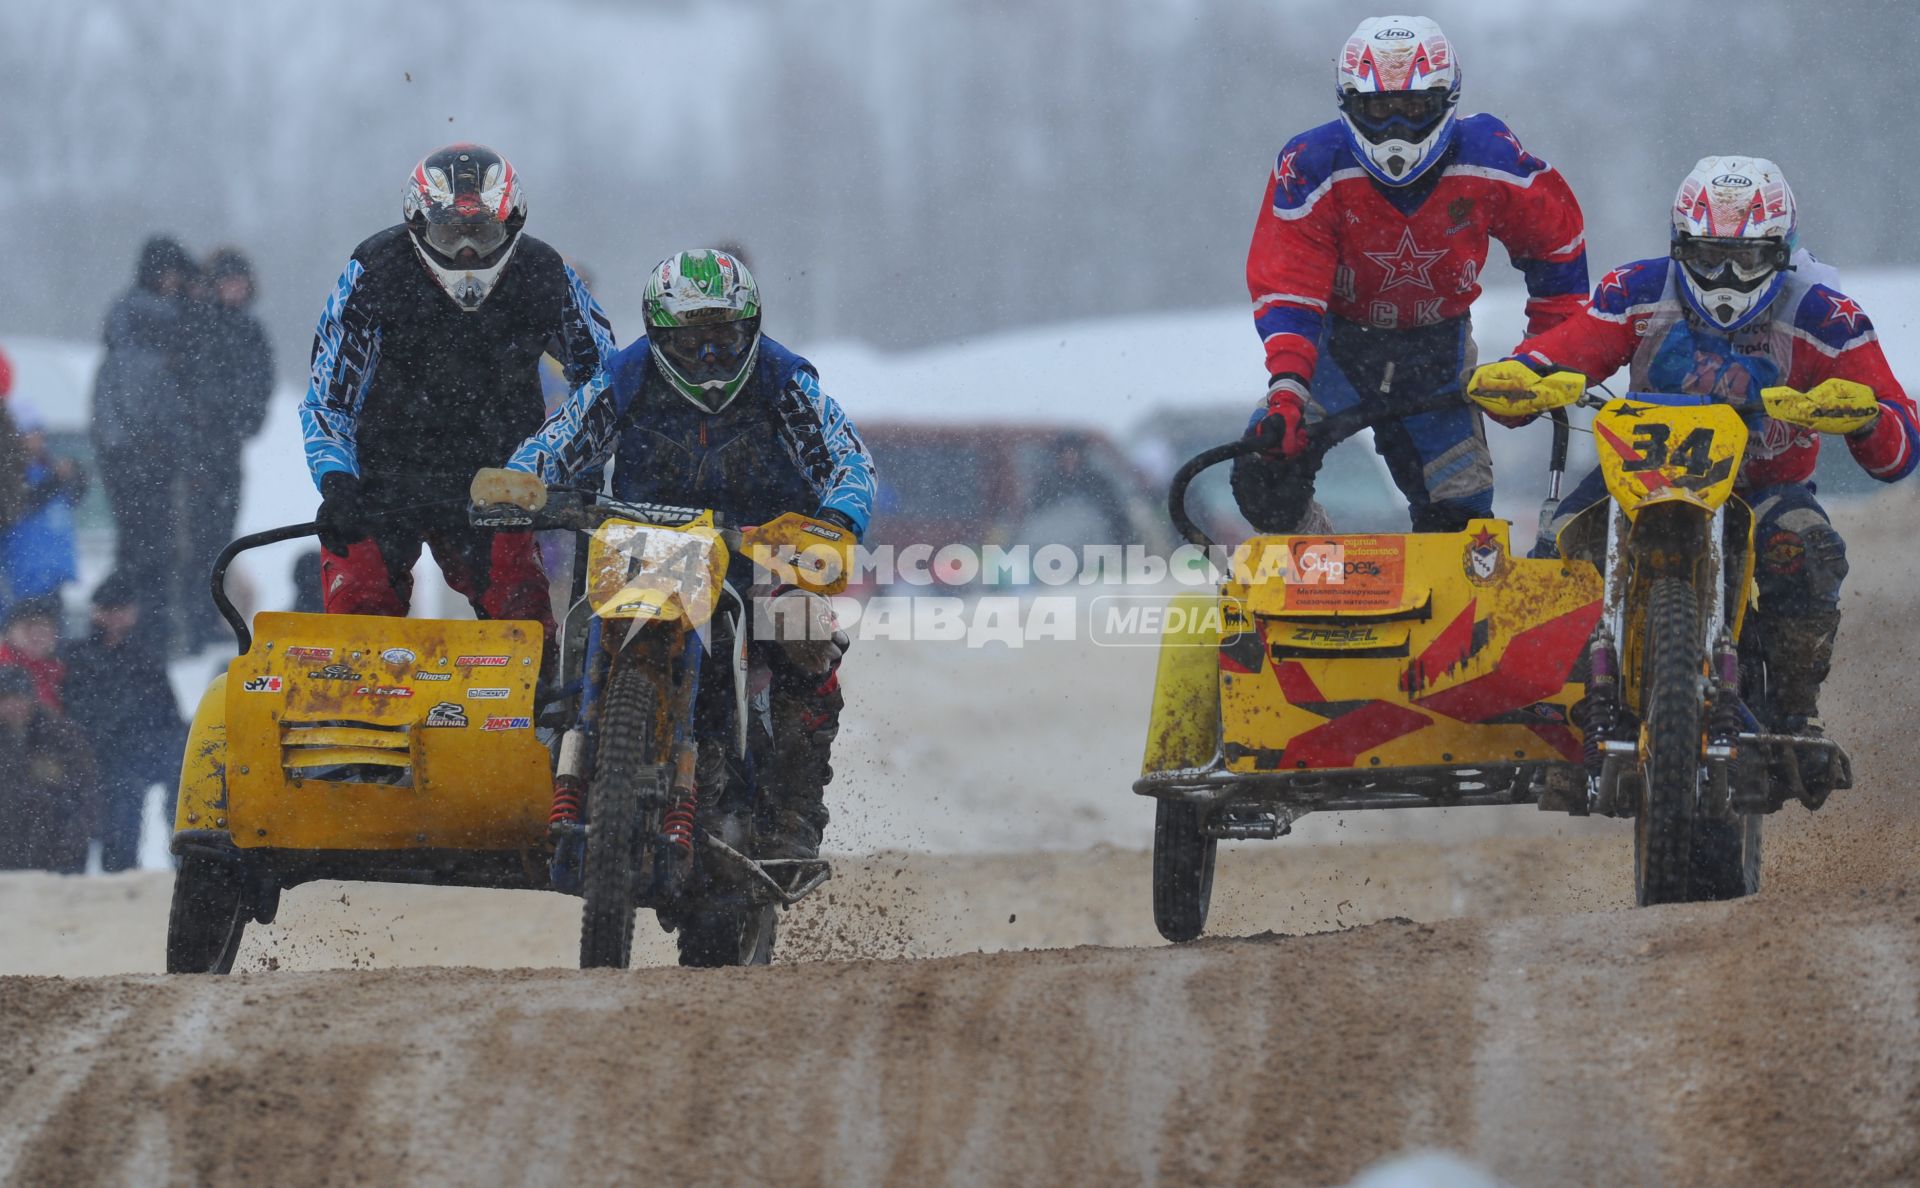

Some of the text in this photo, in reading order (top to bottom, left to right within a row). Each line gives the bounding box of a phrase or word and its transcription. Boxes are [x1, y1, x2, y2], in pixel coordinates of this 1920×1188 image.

[1379, 29, 1410, 37] Arai
[1714, 175, 1748, 184] Arai
[1622, 423, 1716, 476] 34
[616, 531, 704, 593] 14
[1291, 628, 1379, 641] ZABEL
[456, 657, 508, 666] BRAKING
[416, 671, 452, 681] Moose
[244, 677, 270, 691] SPY
[477, 689, 509, 697] SCOTT
[426, 719, 467, 728] RENTHAL
[484, 717, 531, 730] AMSOIL
